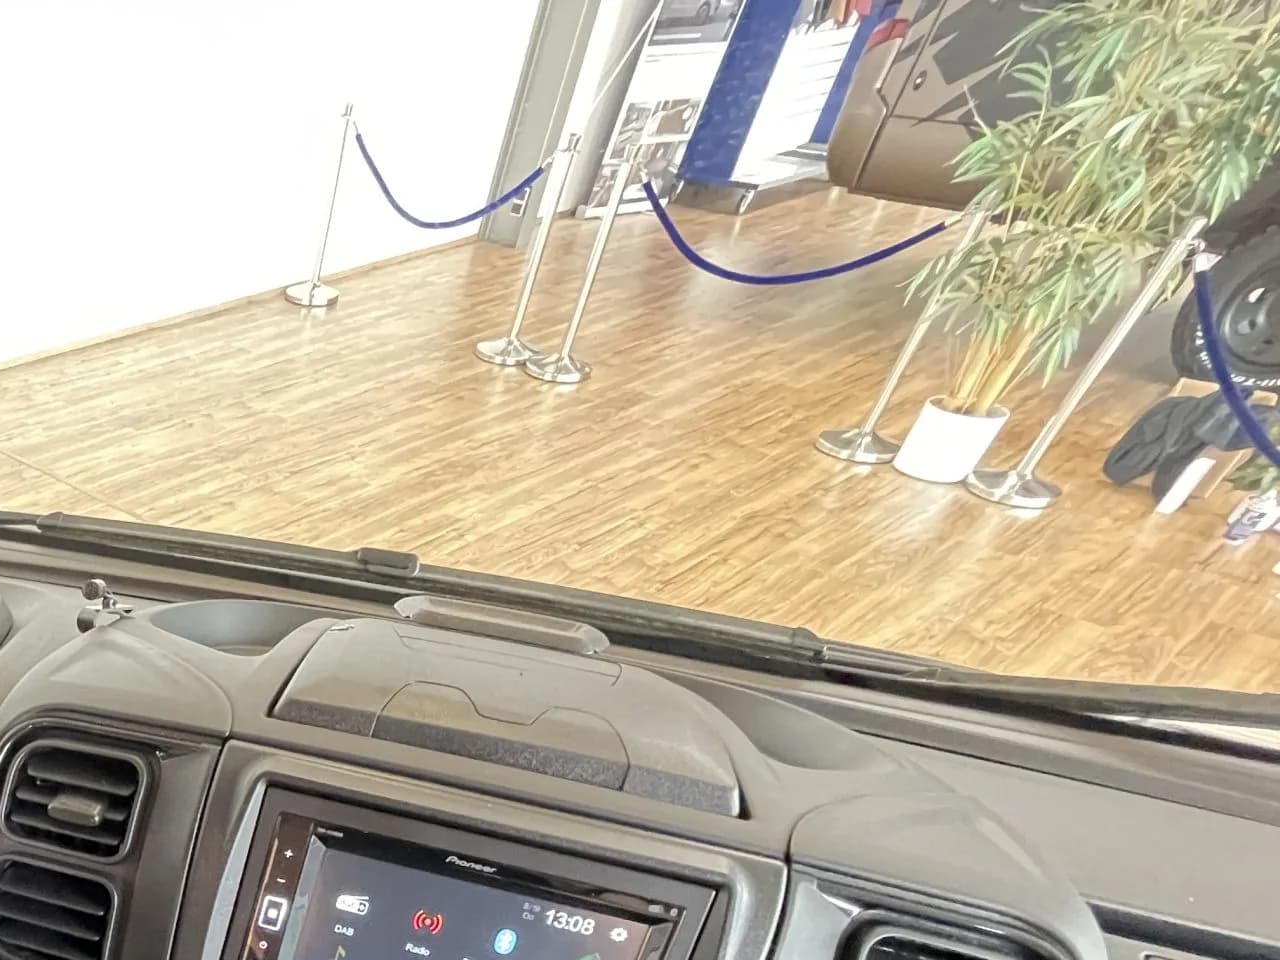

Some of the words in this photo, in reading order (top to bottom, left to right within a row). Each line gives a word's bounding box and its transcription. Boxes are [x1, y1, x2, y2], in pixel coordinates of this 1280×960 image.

[445, 855, 497, 873] Pioneer
[334, 924, 355, 936] DAB
[545, 909, 596, 935] 13:08
[405, 942, 431, 957] Radio
